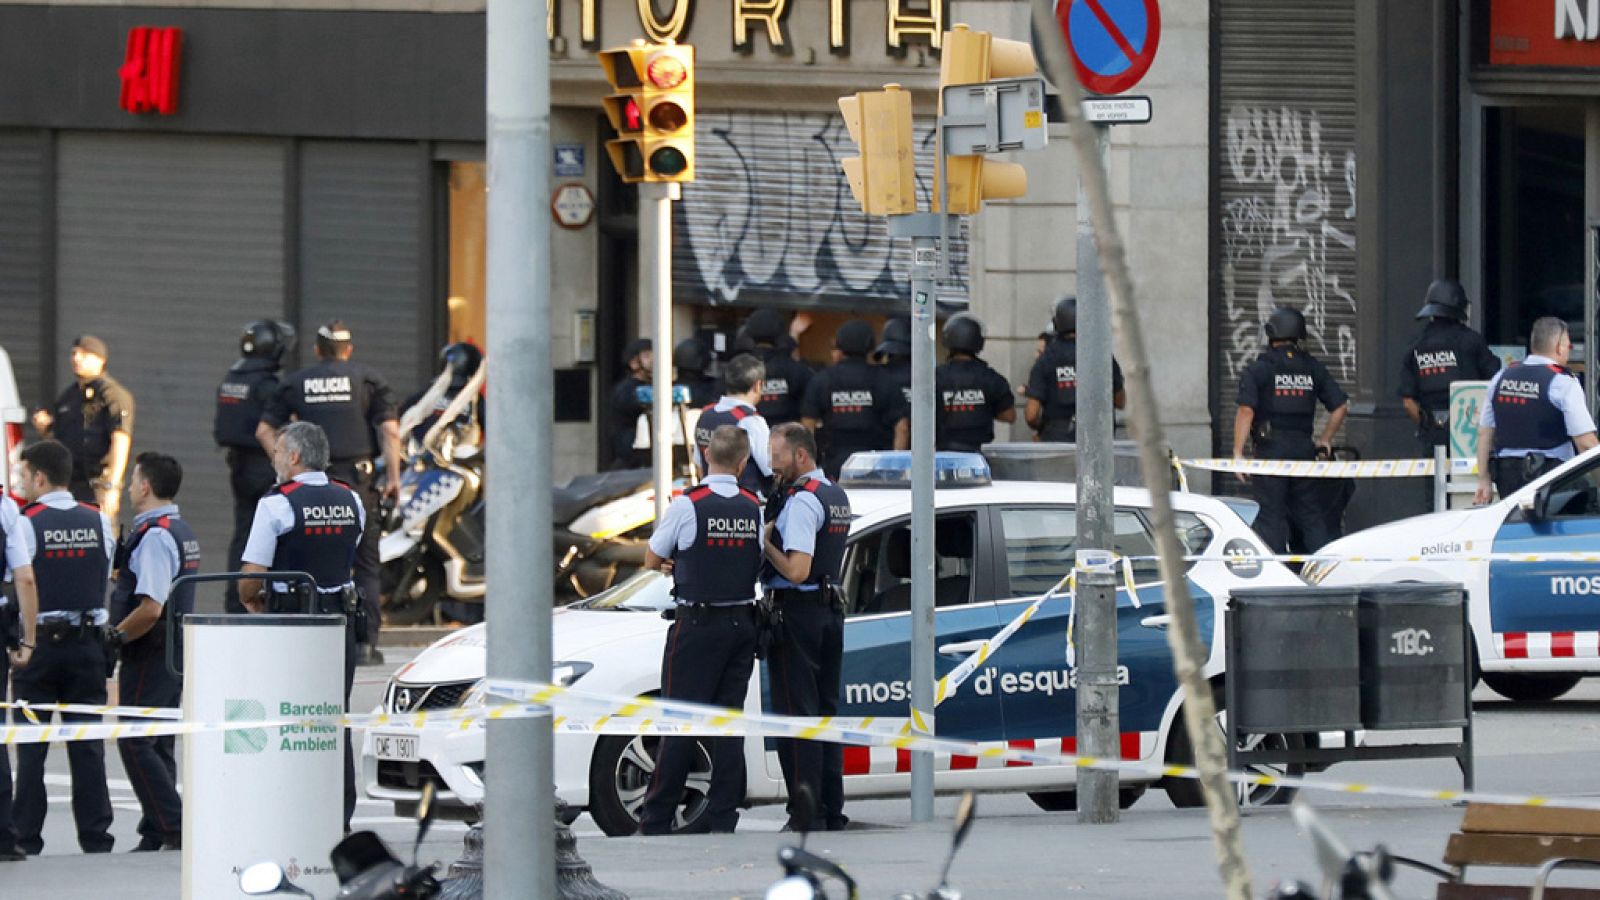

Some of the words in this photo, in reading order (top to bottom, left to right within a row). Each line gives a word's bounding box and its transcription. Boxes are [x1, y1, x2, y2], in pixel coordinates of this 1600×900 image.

[1416, 350, 1456, 365] POLICIA
[304, 376, 351, 394] POLICIA
[1275, 374, 1313, 386] POLICIA
[1500, 379, 1540, 394] POLICIA
[831, 390, 872, 403] POLICIA
[302, 505, 355, 520] POLICIA
[708, 518, 757, 531] POLICIA
[44, 528, 98, 542] POLICIA
[280, 737, 337, 751] Ambient
[395, 738, 415, 758] 1901
